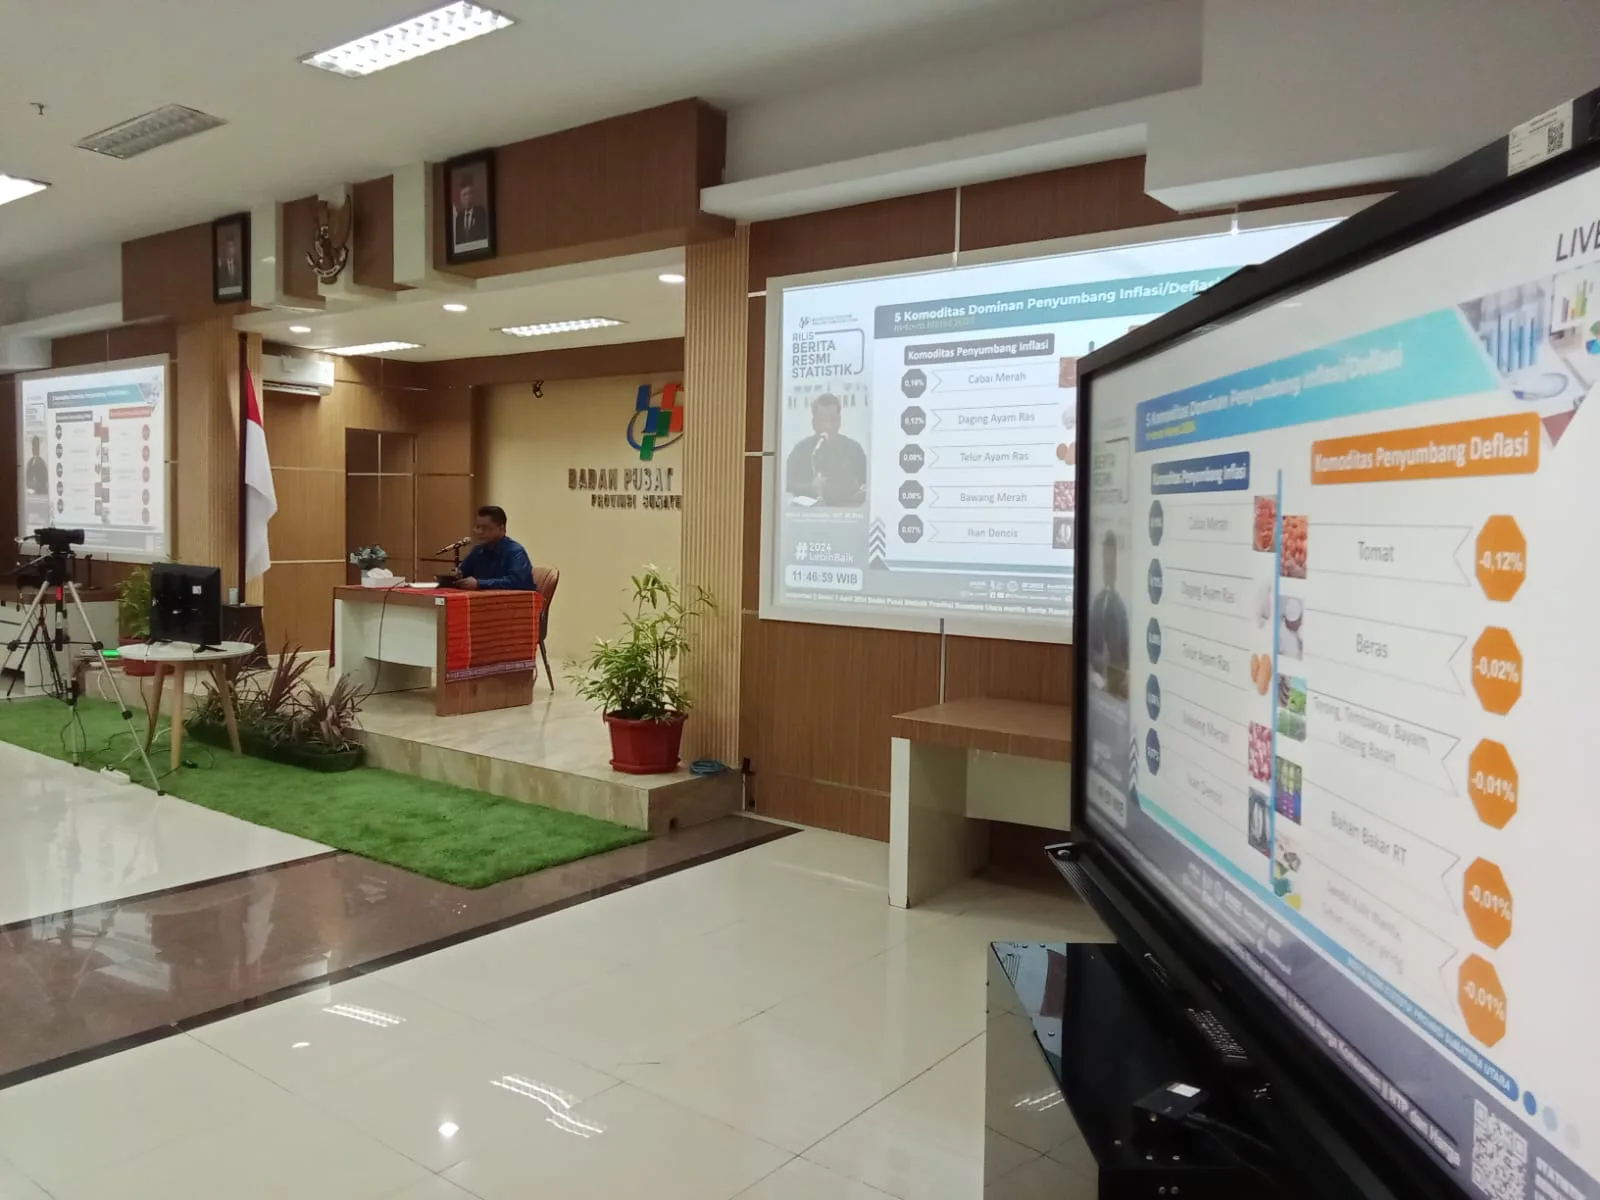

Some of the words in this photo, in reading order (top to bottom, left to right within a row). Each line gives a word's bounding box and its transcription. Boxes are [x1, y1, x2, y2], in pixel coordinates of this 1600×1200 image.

[894, 312, 902, 323] 5
[904, 306, 965, 321] Komoditas
[968, 300, 1024, 315] Dominan
[1027, 288, 1116, 312] Penyumbang
[1119, 277, 1223, 299] Inflasi/Deflas
[792, 332, 814, 341] RILIS
[792, 340, 836, 354] BERITA
[792, 352, 831, 366] RESMI
[908, 349, 954, 360] Komoditas
[956, 343, 1016, 357] Penyumbang
[1019, 339, 1049, 352] Inflasi
[792, 364, 853, 379] STATISTIK
[996, 372, 1026, 383] Merah
[958, 414, 988, 426] Daging
[990, 413, 1016, 425] Ayam
[1018, 413, 1036, 422] Ras
[960, 452, 982, 462] Telur
[984, 452, 1010, 463] Ayam
[1013, 452, 1029, 461] Ras
[1315, 450, 1373, 472] Komoditas
[1376, 441, 1466, 471] Penyumbang
[1470, 431, 1529, 461] Deflasi
[624, 467, 674, 491] PUSAT
[960, 493, 994, 503] Bawang
[997, 493, 1027, 502] Merah
[1357, 541, 1395, 562] Tomat
[1479, 551, 1524, 573] -0,12%
[837, 573, 858, 584] WIB
[1356, 633, 1388, 658] Beras
[1475, 656, 1519, 683] -0,02%
[1471, 770, 1515, 803] -0,01%
[1393, 844, 1407, 866] RT
[1468, 885, 1512, 921] -0,01%
[1463, 981, 1505, 1021] -0,01%
